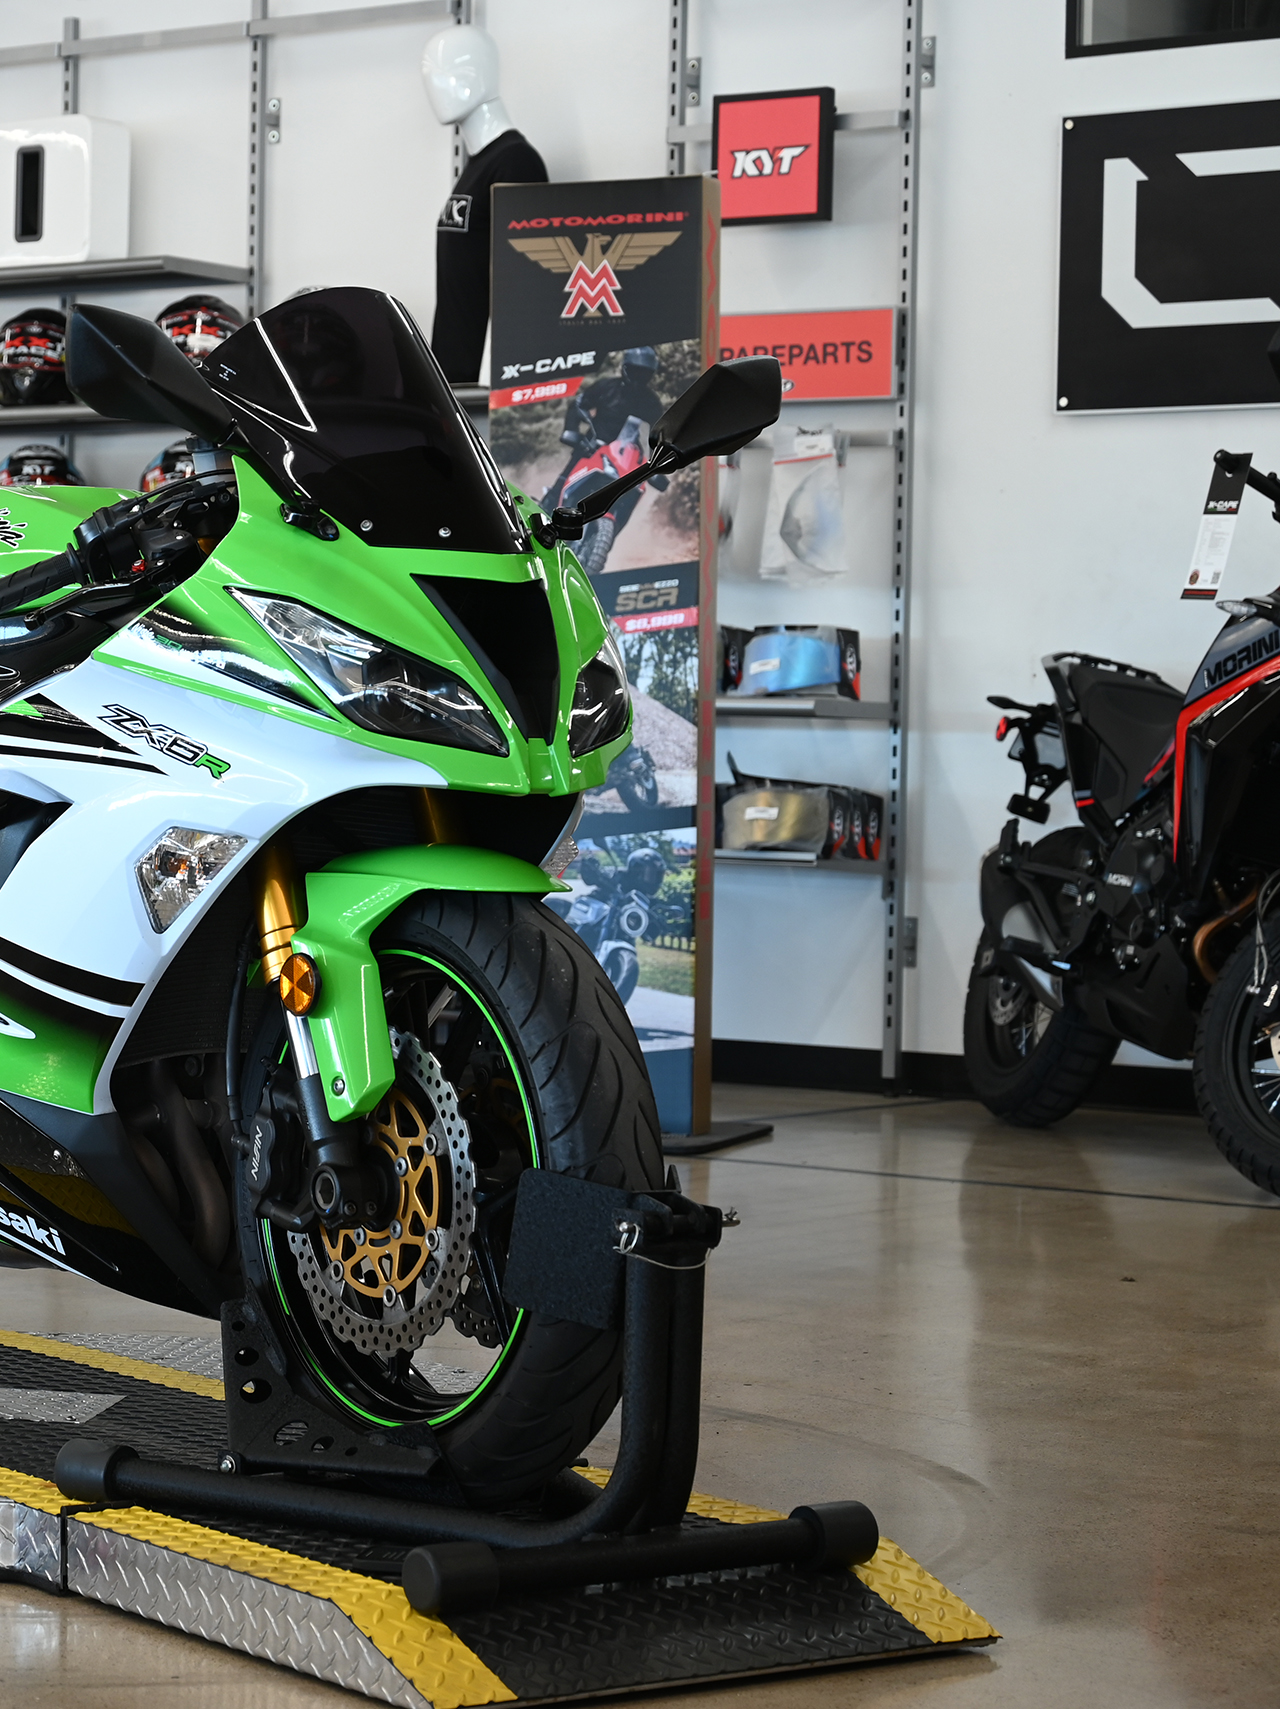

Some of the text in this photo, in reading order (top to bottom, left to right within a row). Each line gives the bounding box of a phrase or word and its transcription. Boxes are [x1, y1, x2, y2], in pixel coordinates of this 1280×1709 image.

[732, 144, 812, 179] KYT
[507, 211, 684, 230] MOTOMORINI
[1206, 628, 1280, 685] MORINI
